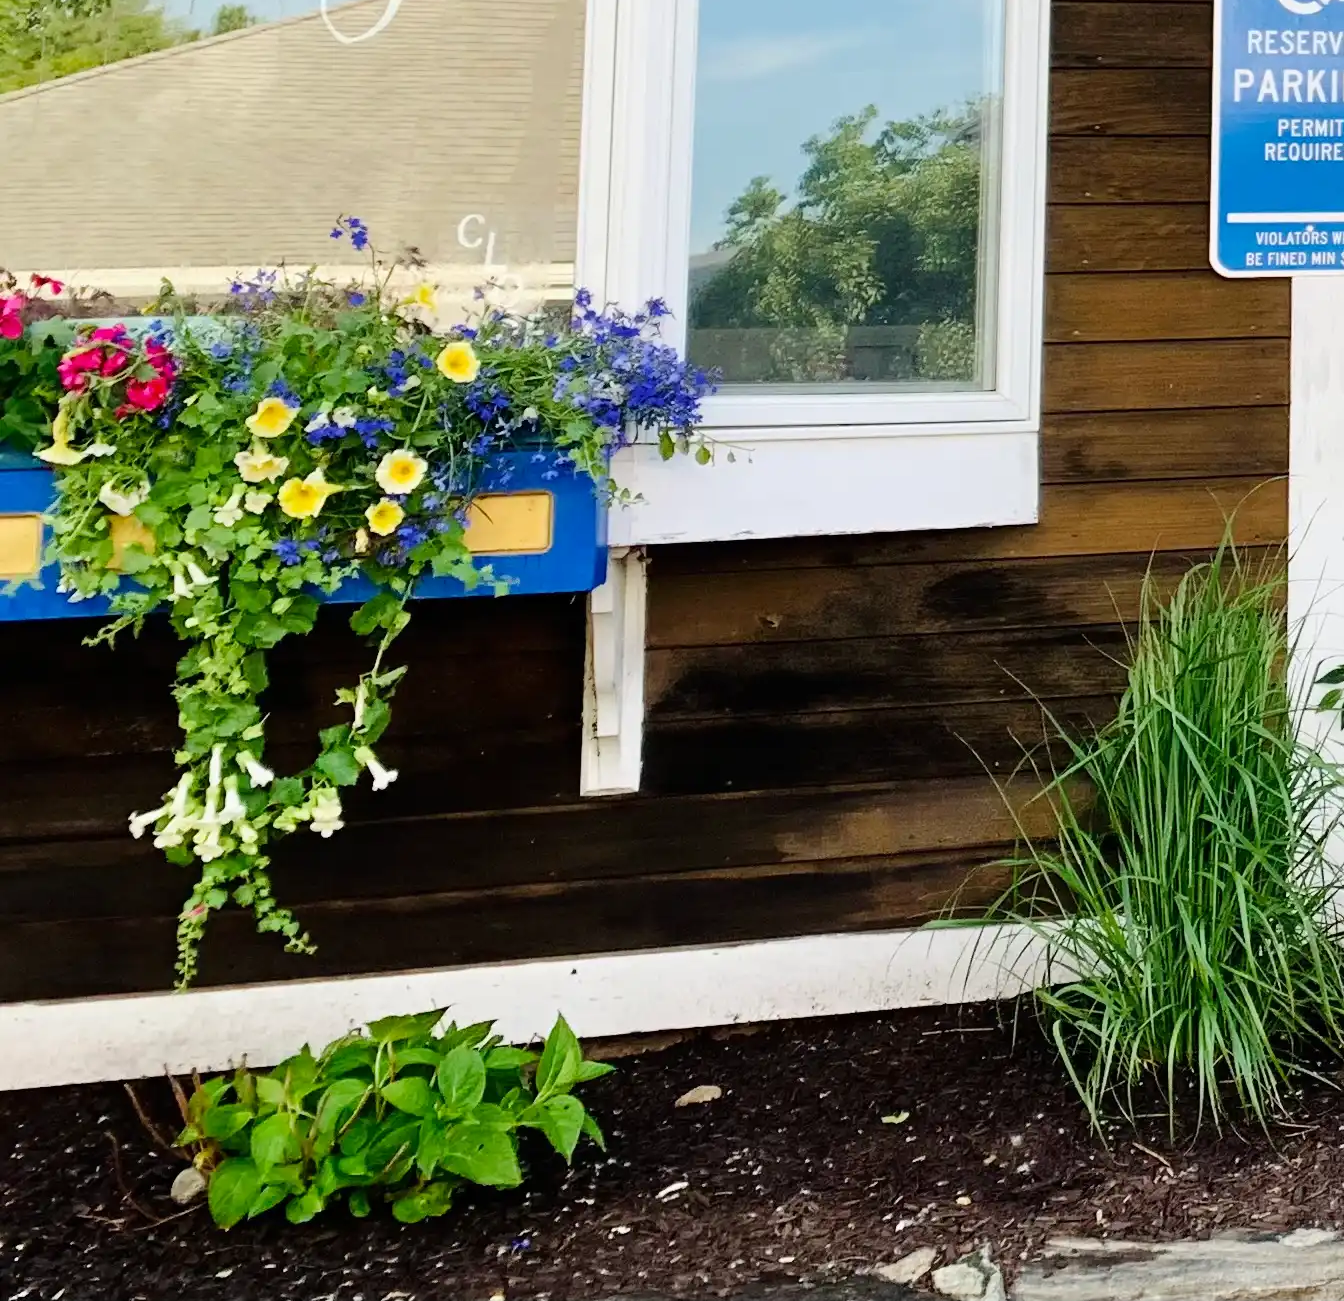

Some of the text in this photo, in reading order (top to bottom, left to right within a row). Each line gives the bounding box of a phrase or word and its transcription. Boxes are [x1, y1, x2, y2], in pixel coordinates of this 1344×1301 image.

[1277, 118, 1344, 138] PERMIT
[1255, 231, 1329, 246] VIOLATORS
[1245, 252, 1264, 267] BE
[1267, 251, 1307, 266] FINED
[1311, 251, 1337, 266] MIN
